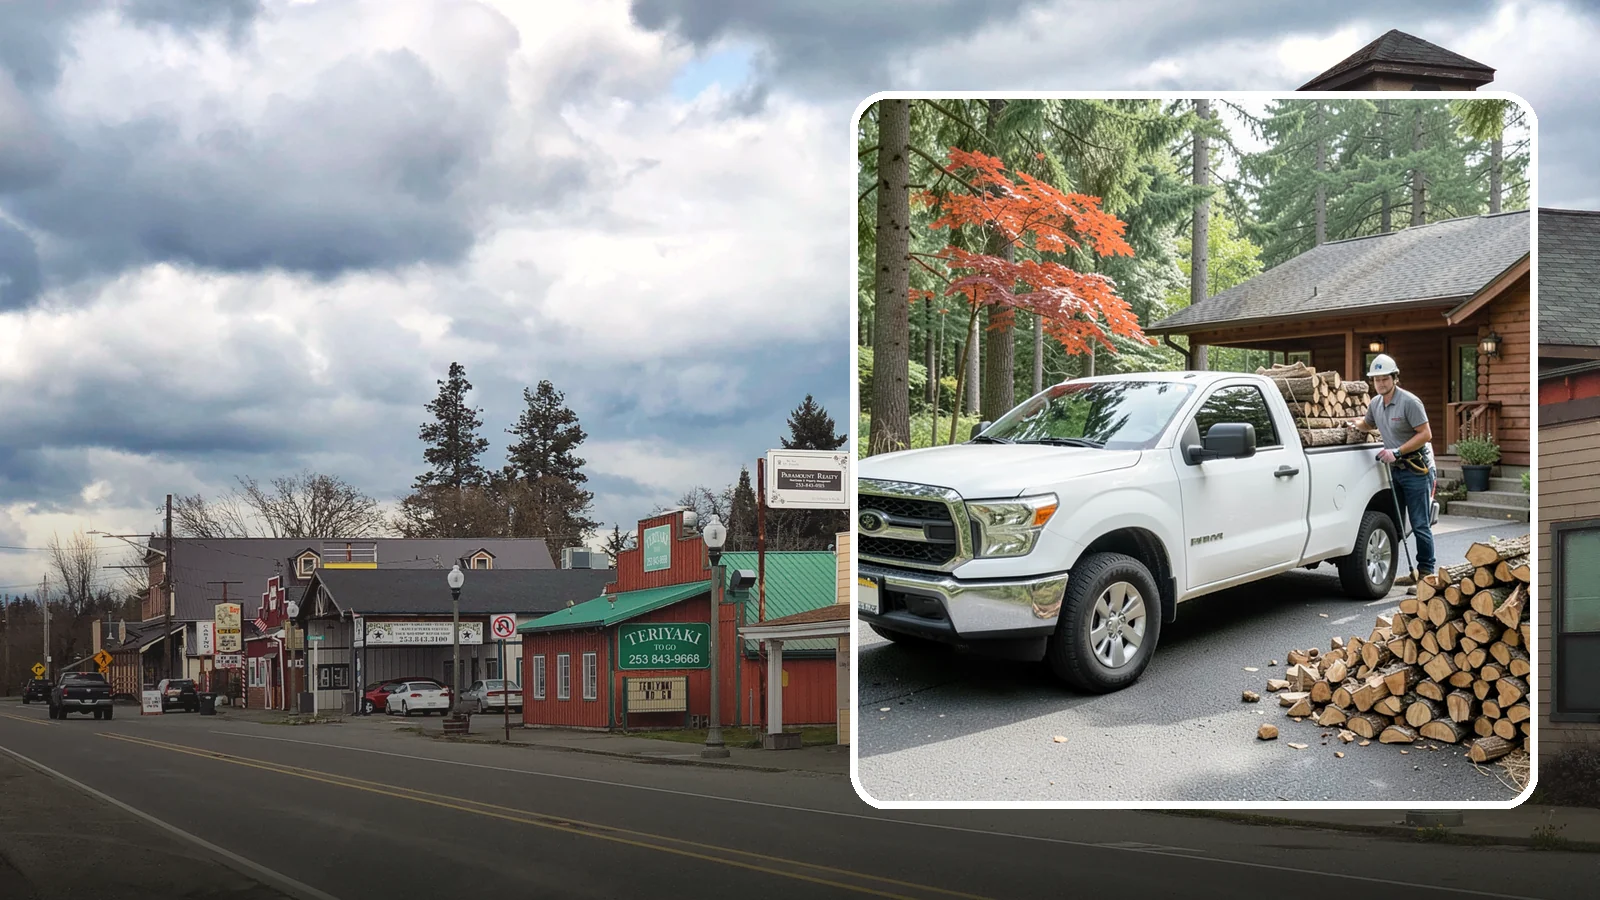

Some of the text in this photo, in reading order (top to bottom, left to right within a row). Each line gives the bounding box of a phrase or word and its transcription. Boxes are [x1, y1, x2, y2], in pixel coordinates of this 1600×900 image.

[781, 471, 839, 480] PARAMOUNT REALTY
[625, 628, 702, 646] TERIYAKI
[629, 654, 700, 664] 253 843-9668
